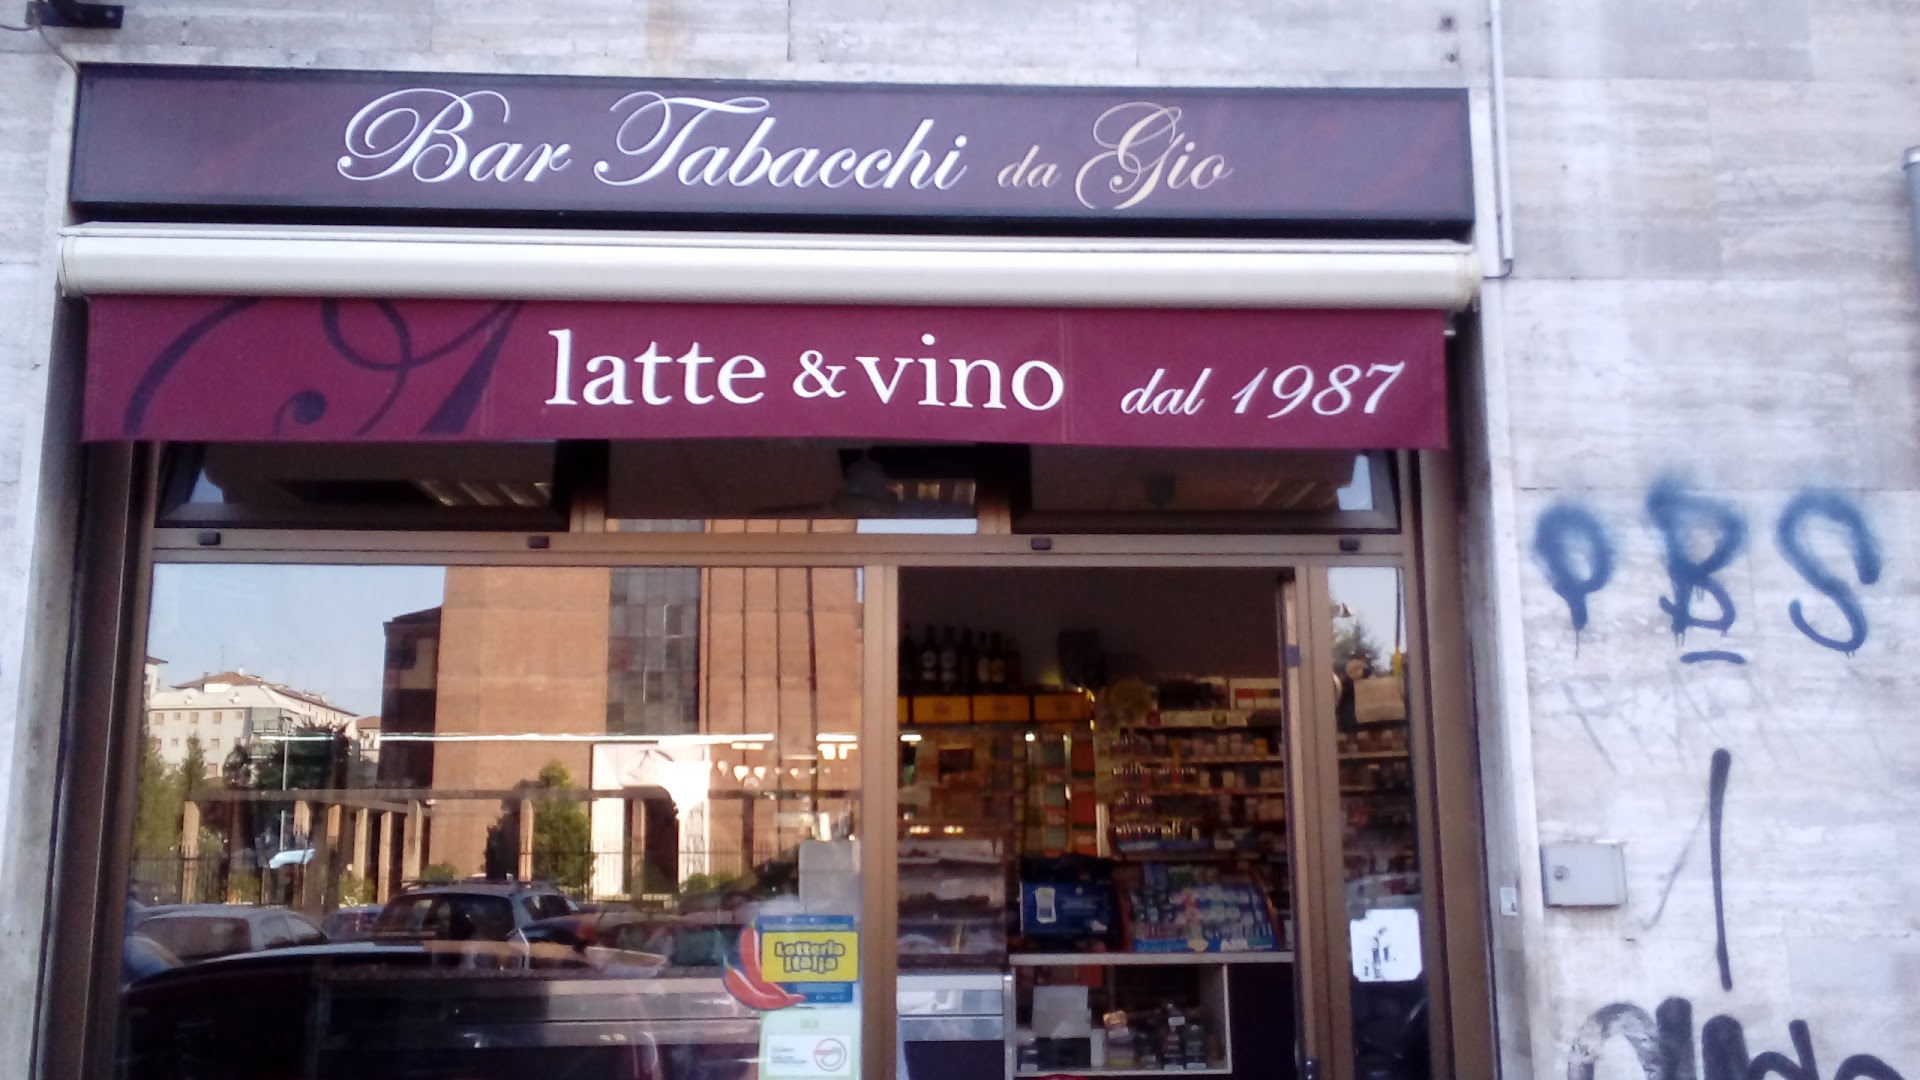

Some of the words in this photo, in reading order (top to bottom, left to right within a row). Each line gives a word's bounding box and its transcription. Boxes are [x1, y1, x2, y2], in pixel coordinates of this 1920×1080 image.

[336, 88, 573, 185] Bar
[592, 91, 968, 190] Tabacchi
[997, 145, 1061, 189] da
[1074, 101, 1234, 210] Gio
[544, 328, 767, 407] latte
[792, 349, 847, 399] &
[854, 333, 1065, 411] vino
[1120, 367, 1214, 416] dal
[1230, 361, 1406, 419] 1987
[775, 940, 846, 956] Lotteria
